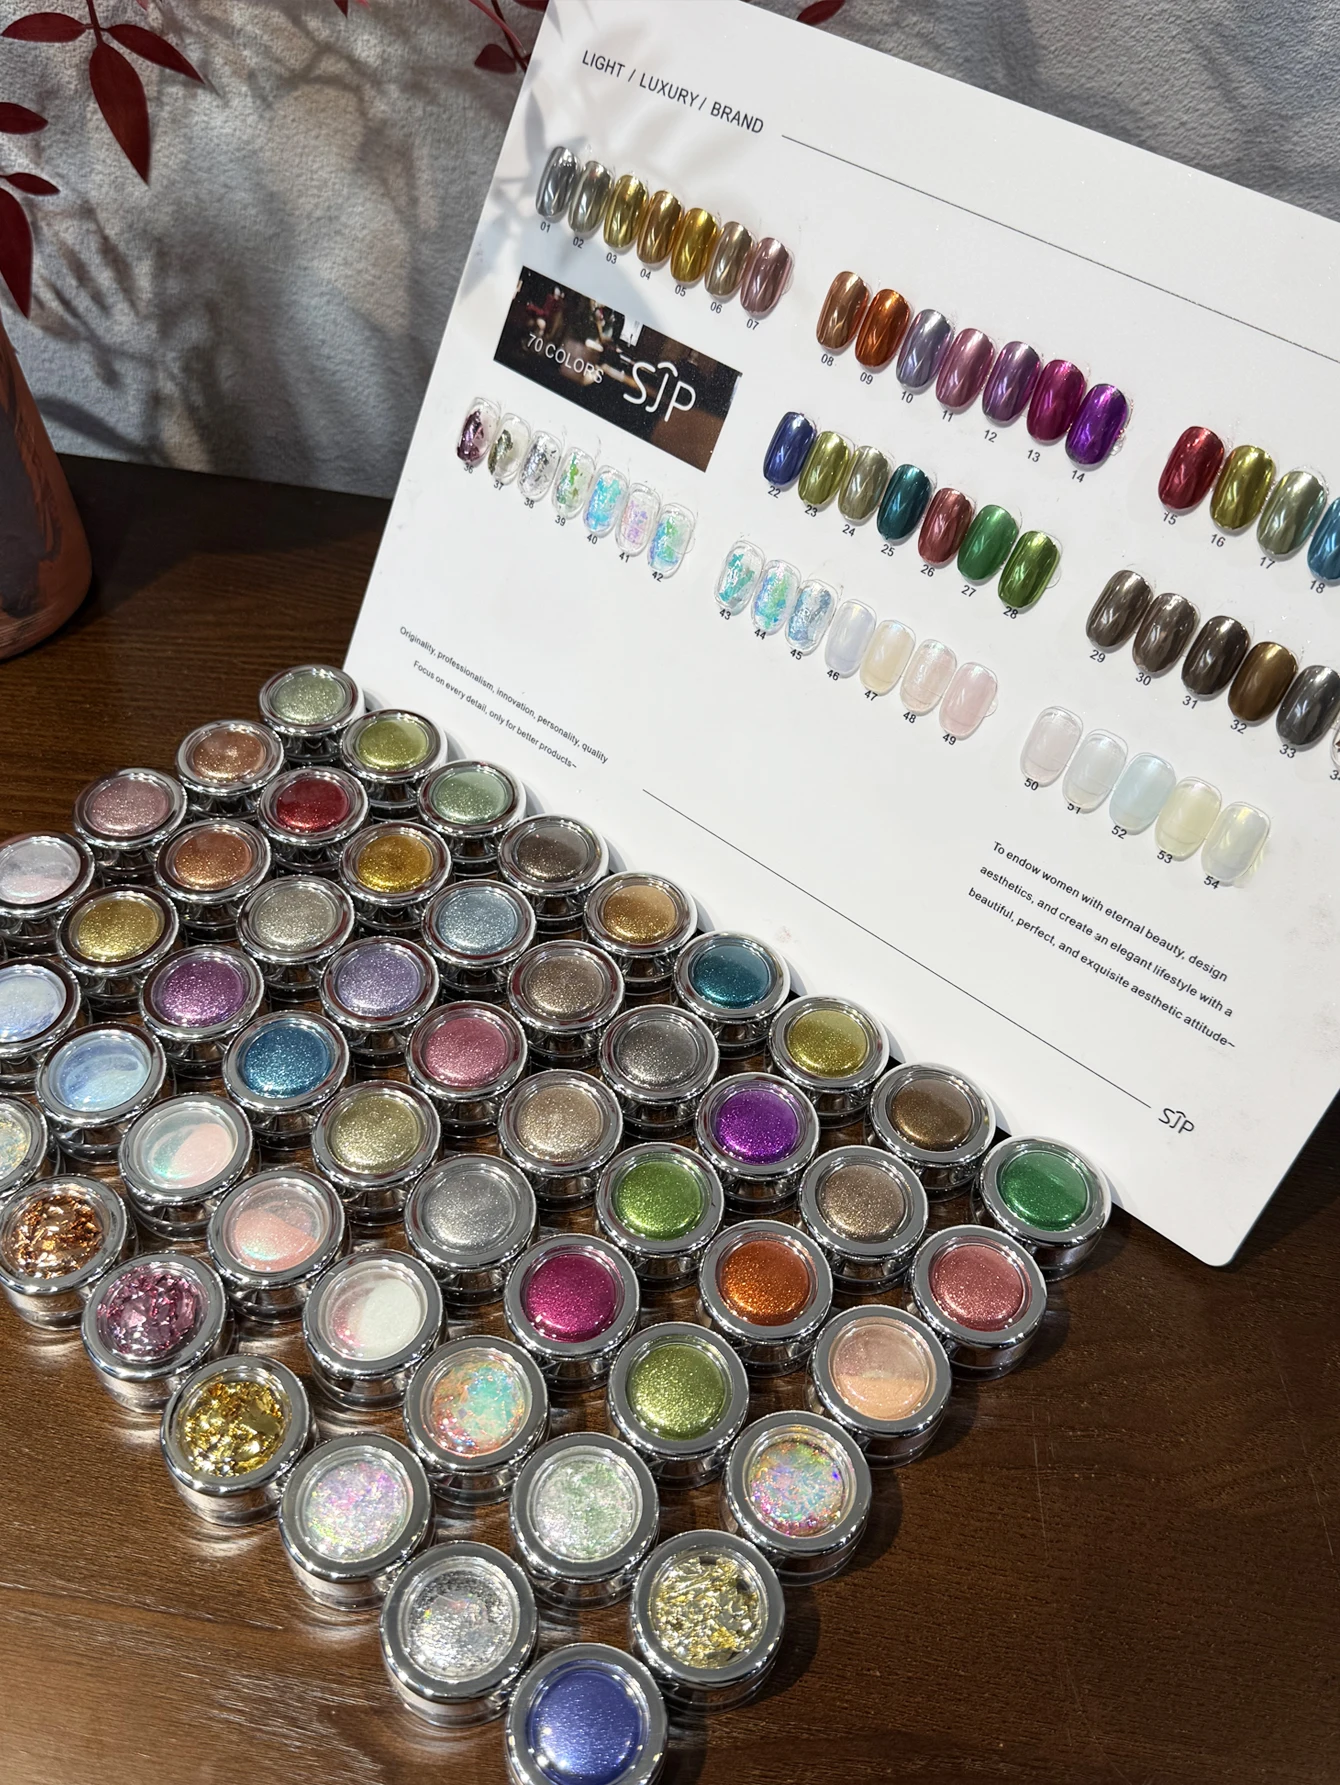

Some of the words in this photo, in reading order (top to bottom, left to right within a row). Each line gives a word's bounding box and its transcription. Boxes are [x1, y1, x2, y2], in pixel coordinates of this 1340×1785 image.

[582, 50, 625, 78] LIGHT
[710, 101, 764, 134] BRAND
[540, 221, 551, 234] 01
[572, 236, 584, 249] 02
[606, 252, 618, 265] 03
[640, 268, 652, 281] 04
[674, 284, 686, 297] 05
[710, 301, 722, 314] 06
[746, 318, 760, 332] 07
[527, 334, 544, 353] 70
[545, 343, 605, 384] COLORS
[820, 353, 834, 367] 08
[860, 372, 874, 385] 09
[900, 391, 914, 404] 10
[942, 410, 954, 422] 11
[984, 429, 998, 443] 12
[1027, 449, 1041, 463] 13
[1071, 469, 1085, 484] 14
[494, 480, 504, 491] 37
[767, 485, 782, 499] 22
[524, 497, 535, 509] 38
[804, 504, 818, 518] 23
[554, 515, 566, 527] 39
[1163, 511, 1177, 526] 15
[842, 523, 857, 538] 24
[586, 533, 598, 545] 40
[1210, 533, 1226, 548] 16
[880, 543, 896, 558] 25
[618, 552, 630, 564] 41
[1260, 556, 1276, 570] 17
[651, 570, 663, 583] 42
[920, 563, 936, 578] 26
[961, 584, 977, 598] 27
[1310, 579, 1326, 594] 18
[719, 608, 731, 621] 43
[1003, 605, 1019, 620] 28
[754, 628, 767, 641] 44
[790, 648, 803, 661] 45
[1089, 649, 1106, 664] 29
[826, 668, 840, 682] 46
[1135, 672, 1152, 687] 30
[399, 626, 437, 657] Originality,
[437, 650, 495, 694] professionalism,
[496, 687, 536, 720] innovation,
[536, 713, 581, 748] personality,
[581, 742, 609, 765] quality
[864, 689, 878, 702] 47
[1182, 695, 1198, 710] 31
[413, 660, 435, 680] Focus
[435, 675, 445, 686] on
[445, 681, 466, 701] every
[465, 694, 488, 716] detail,
[489, 709, 505, 726] only
[505, 719, 517, 732] for
[516, 727, 540, 747] better
[902, 710, 917, 724] 48
[1230, 718, 1248, 734] 32
[942, 732, 957, 746] 49
[1279, 744, 1296, 758] 33
[1024, 777, 1040, 792] 50
[1111, 824, 1127, 840] 52
[1156, 849, 1173, 865] 53
[1203, 875, 1221, 890] 54
[993, 841, 1005, 855] To
[1006, 851, 1042, 876] endow
[1041, 871, 1080, 898] women
[1081, 892, 1104, 912] with
[1104, 907, 1147, 936] eternal
[1145, 928, 1186, 961] beauty,
[1188, 953, 1228, 983] design
[980, 865, 1035, 905] aesthetics,
[1037, 898, 1058, 916] and
[1059, 911, 1094, 936] create
[1094, 930, 1109, 946] an
[1110, 940, 1153, 972] elegant
[1152, 964, 1198, 997] lifestyle
[1199, 990, 1223, 1011] with
[1224, 1006, 1233, 1018] a
[968, 887, 1015, 923] beautiful,
[1016, 915, 1056, 948] perfect,
[1058, 940, 1080, 959] and
[1080, 953, 1130, 988] exquisite
[1130, 983, 1184, 1020] aesthetic
